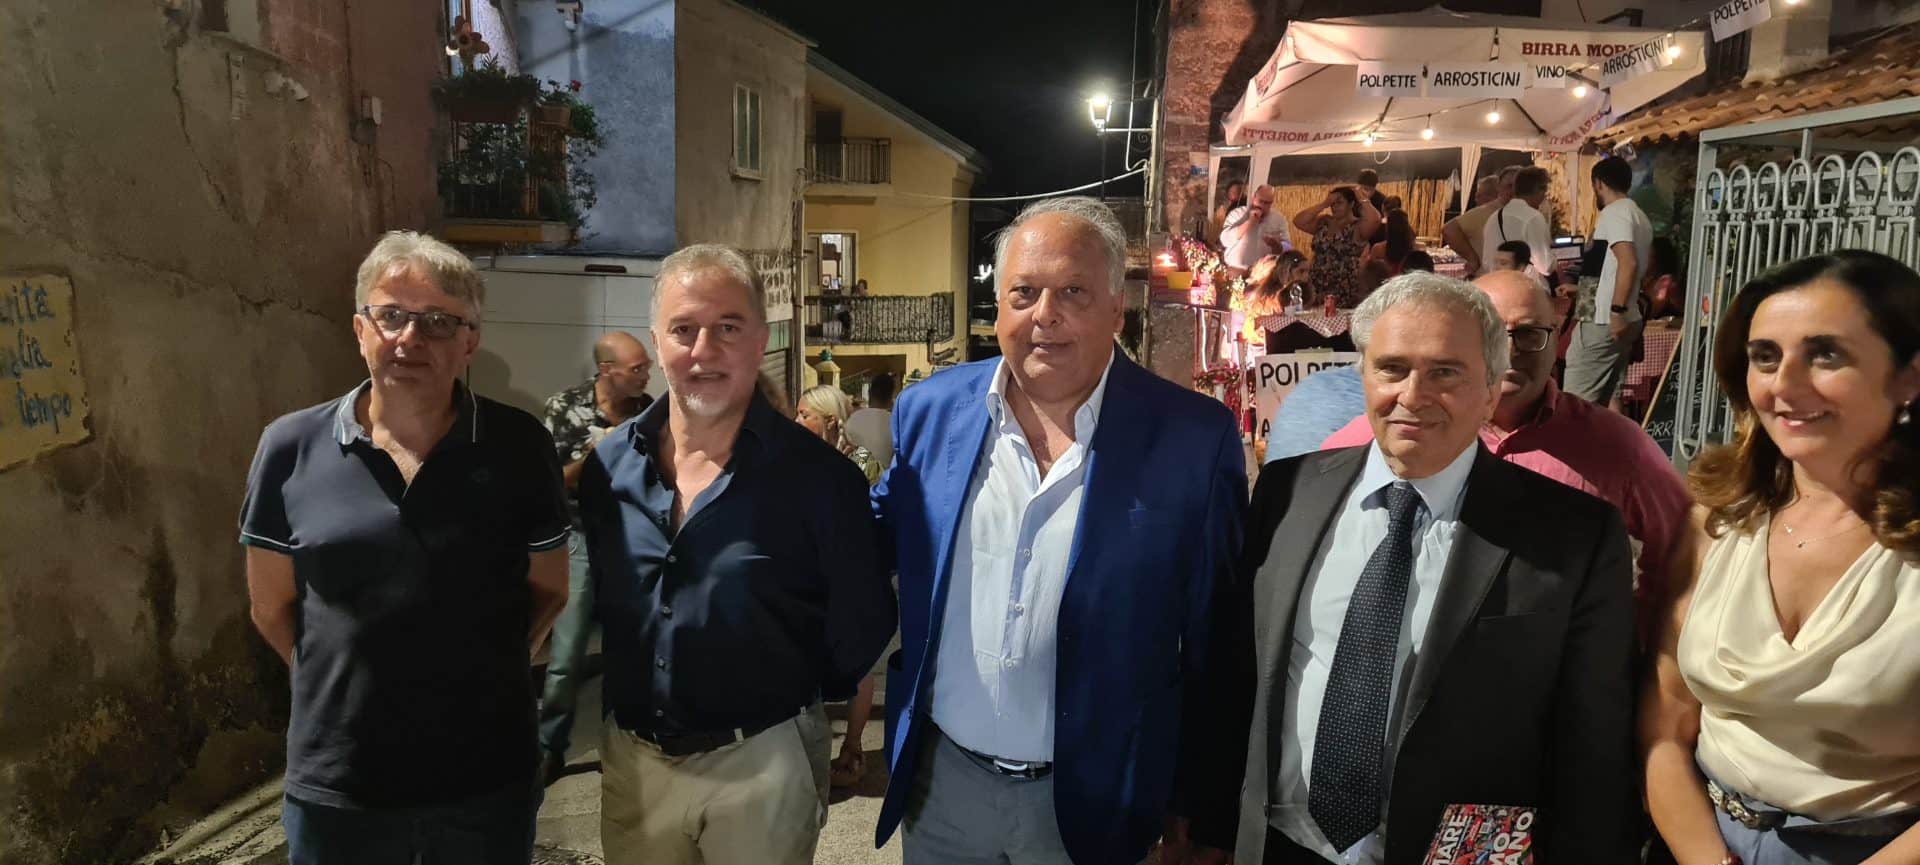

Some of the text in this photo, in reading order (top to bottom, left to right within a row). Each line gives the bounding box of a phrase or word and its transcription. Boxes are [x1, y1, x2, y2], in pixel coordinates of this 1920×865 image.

[1713, 0, 1765, 24] POLPET
[1522, 42, 1637, 57] BIRRA MOR
[1602, 38, 1665, 77] ARROSTICINI
[1433, 71, 1521, 87] ARROSTICINI
[1536, 64, 1565, 79] VINO
[1360, 74, 1417, 88] POLPETTE
